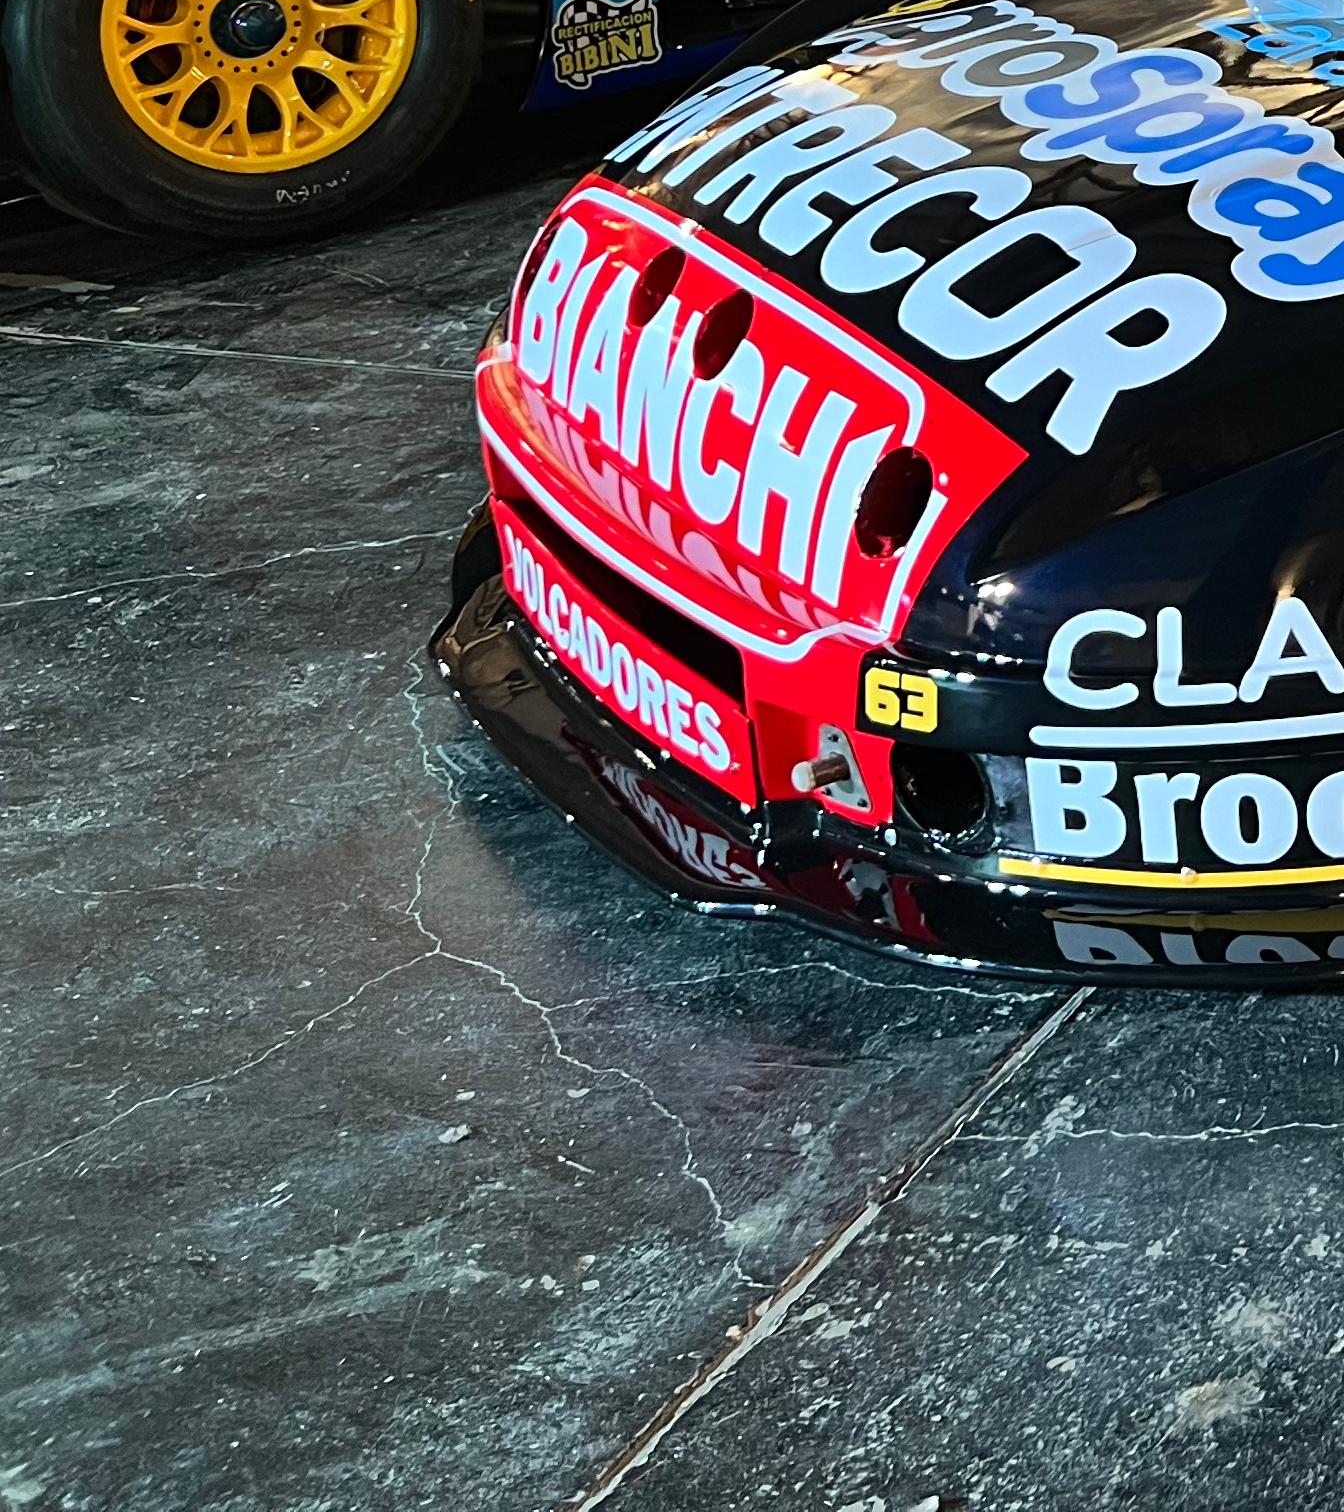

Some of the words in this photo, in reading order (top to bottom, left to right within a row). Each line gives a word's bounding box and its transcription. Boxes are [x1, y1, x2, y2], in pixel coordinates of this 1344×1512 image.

[558, 10, 652, 40] RECTIFICACION
[560, 23, 656, 77] BIBINI
[514, 215, 898, 609] BIANCHI
[502, 523, 732, 773] VOLCADORES
[864, 667, 938, 733] 63
